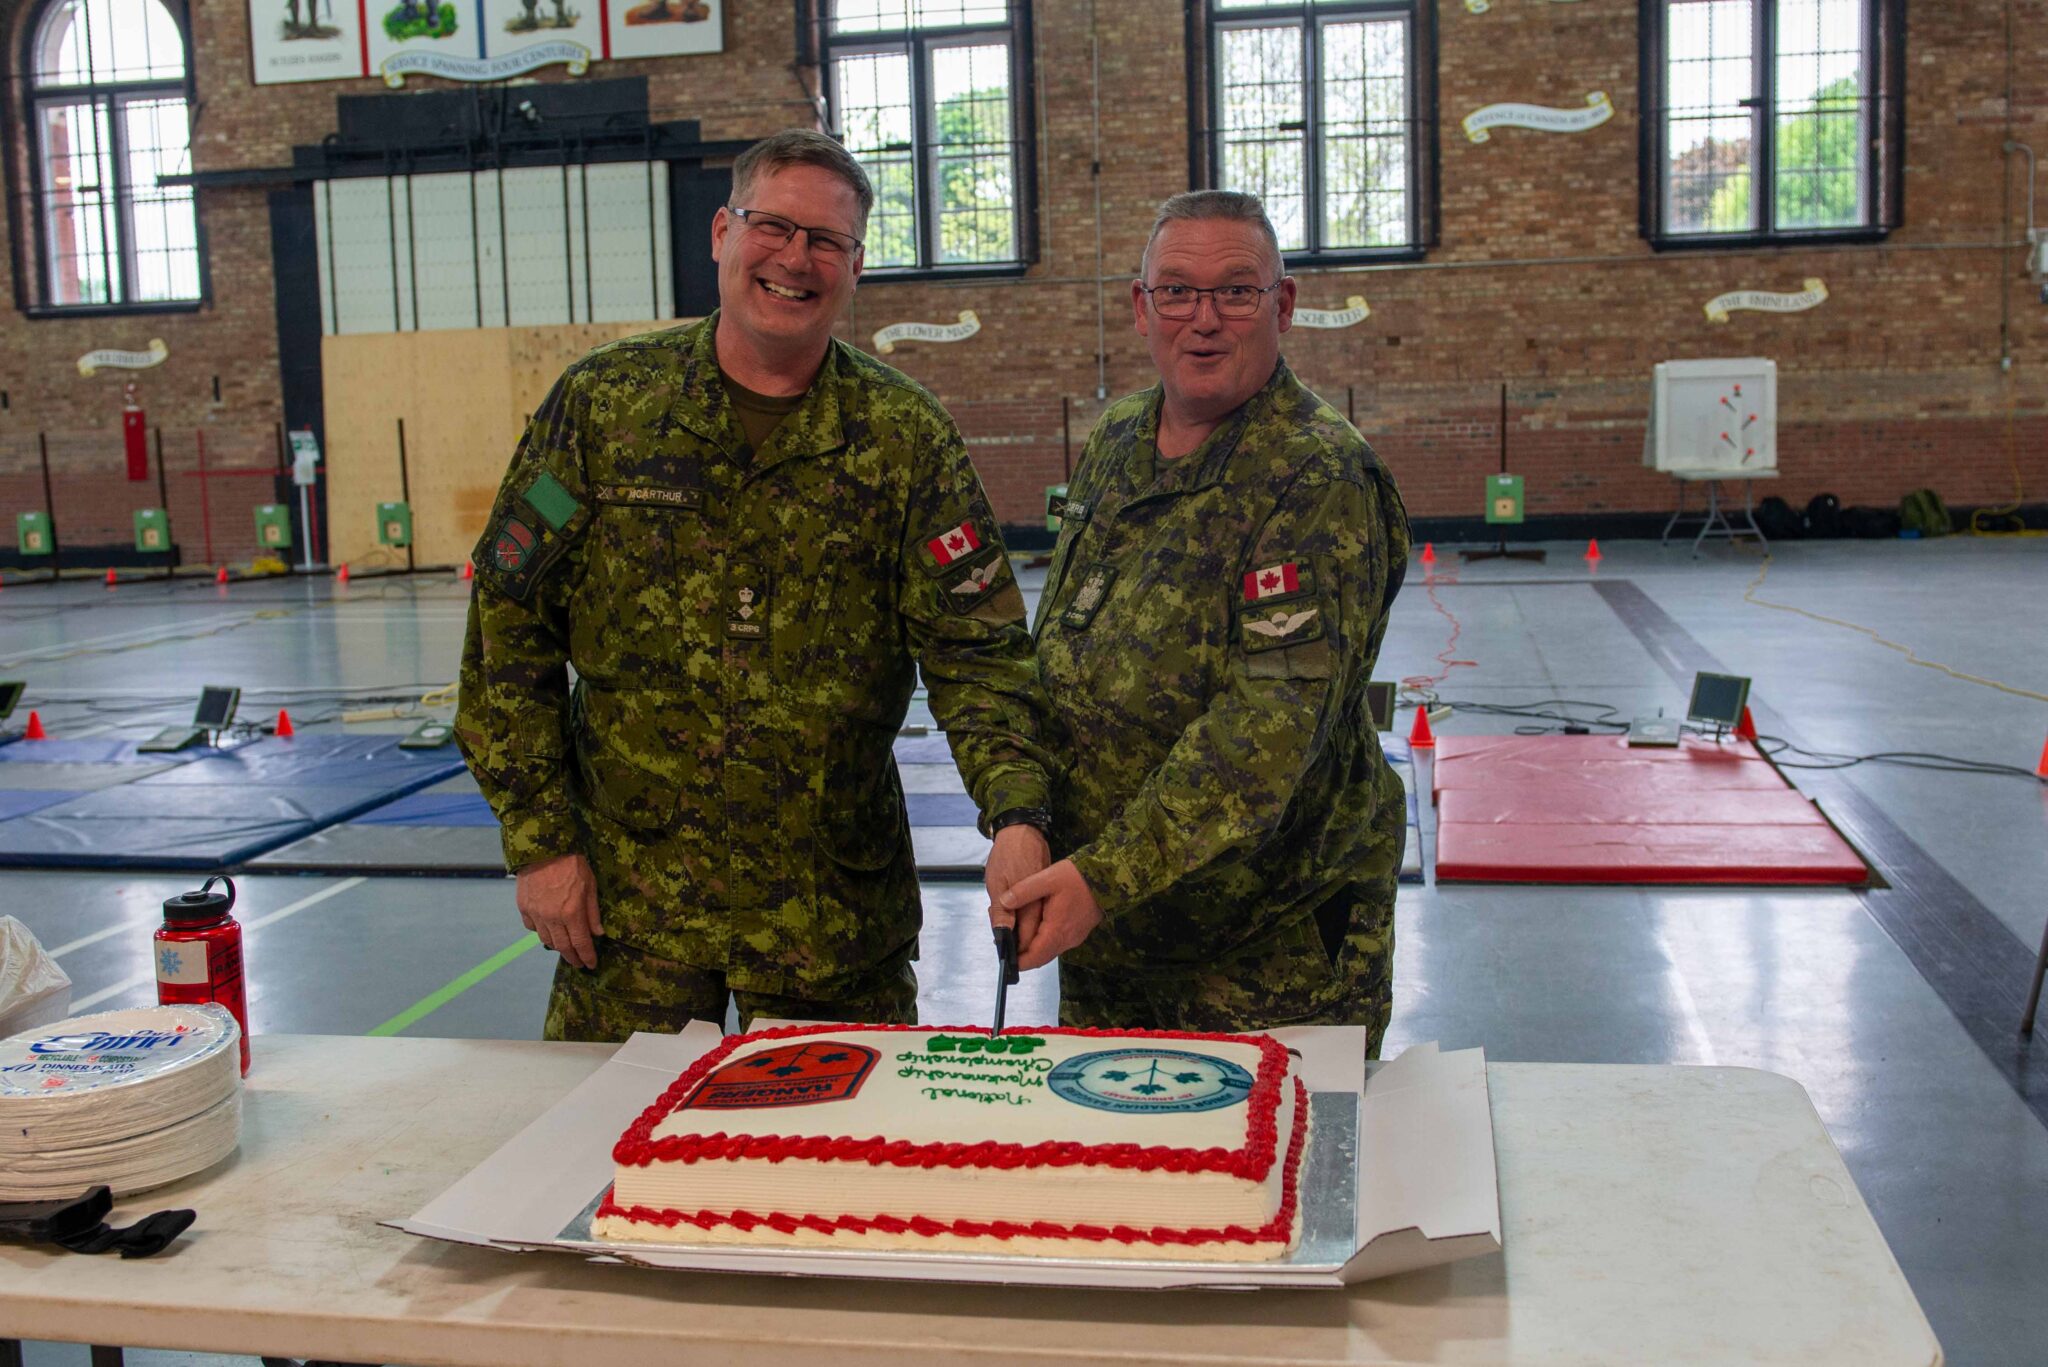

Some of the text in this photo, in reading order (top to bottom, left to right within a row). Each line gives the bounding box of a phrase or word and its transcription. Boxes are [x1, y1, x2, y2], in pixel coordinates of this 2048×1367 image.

[431, 57, 488, 74] SPANNING
[491, 56, 522, 72] FOUR
[522, 45, 583, 64] CENTURIES
[884, 326, 904, 340] THE
[907, 325, 944, 339] LOWER
[628, 489, 683, 501] MCARTHUR
[729, 622, 737, 632] 3
[41, 1063, 89, 1071] DINNER
[707, 1084, 833, 1099] RANGERS
[1112, 1102, 1191, 1111] CANADIAN
